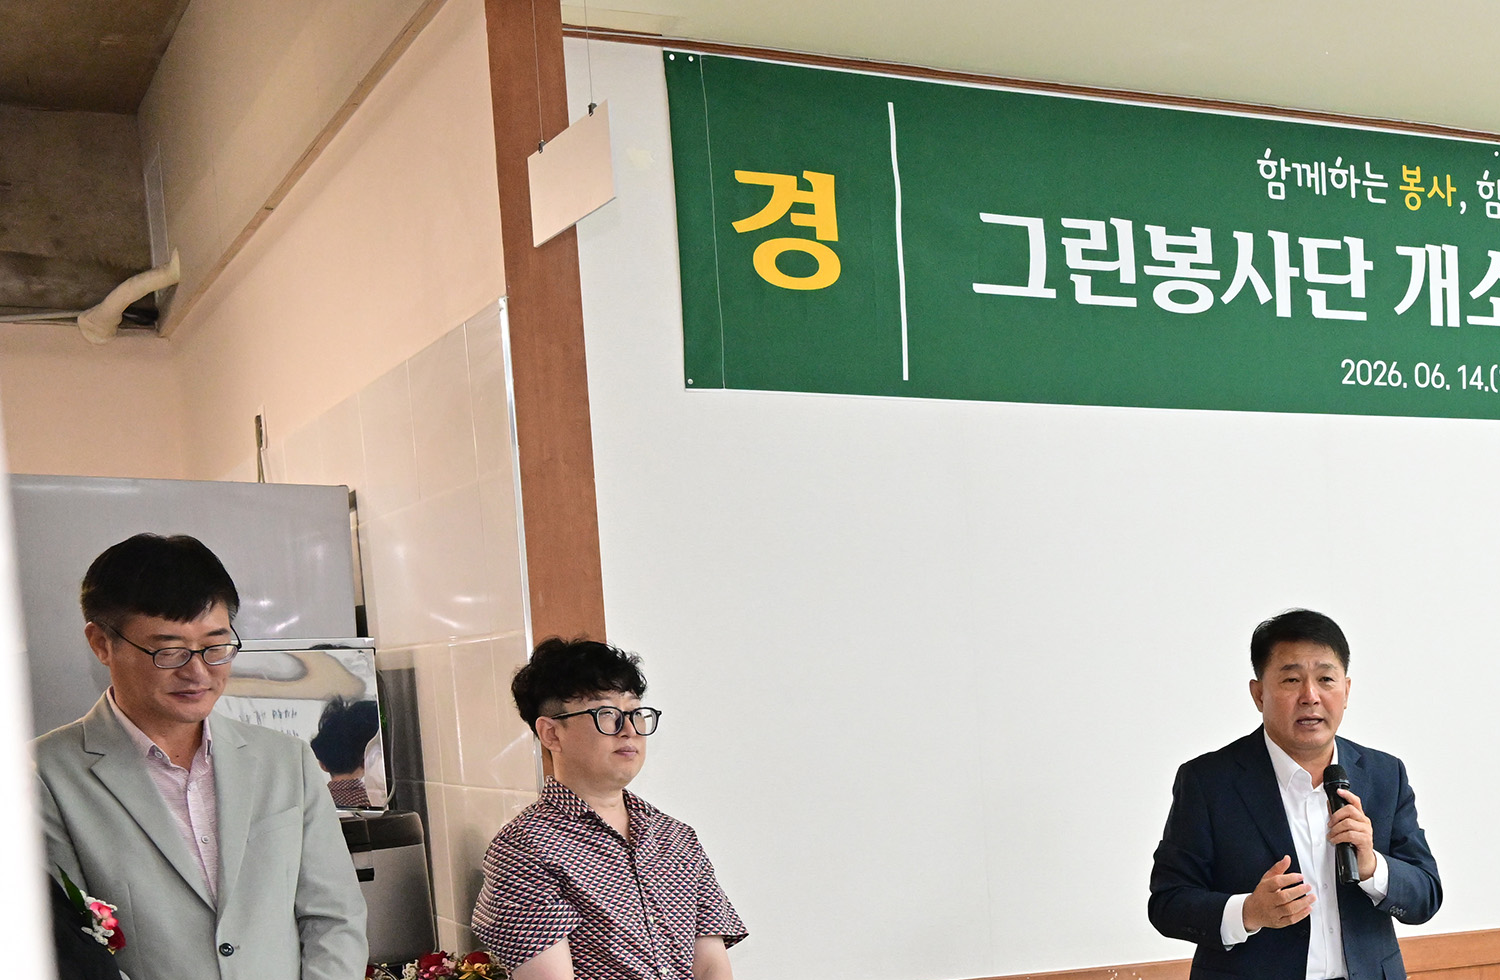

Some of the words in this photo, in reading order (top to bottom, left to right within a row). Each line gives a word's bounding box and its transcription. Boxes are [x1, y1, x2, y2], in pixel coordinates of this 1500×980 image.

[1257, 148, 1388, 203] 함께하는
[1400, 165, 1466, 214] 봉사,
[732, 170, 841, 290] 경
[973, 213, 1373, 321] 그린봉사단
[1341, 359, 1407, 388] 2026.
[1415, 363, 1450, 390] 06.
